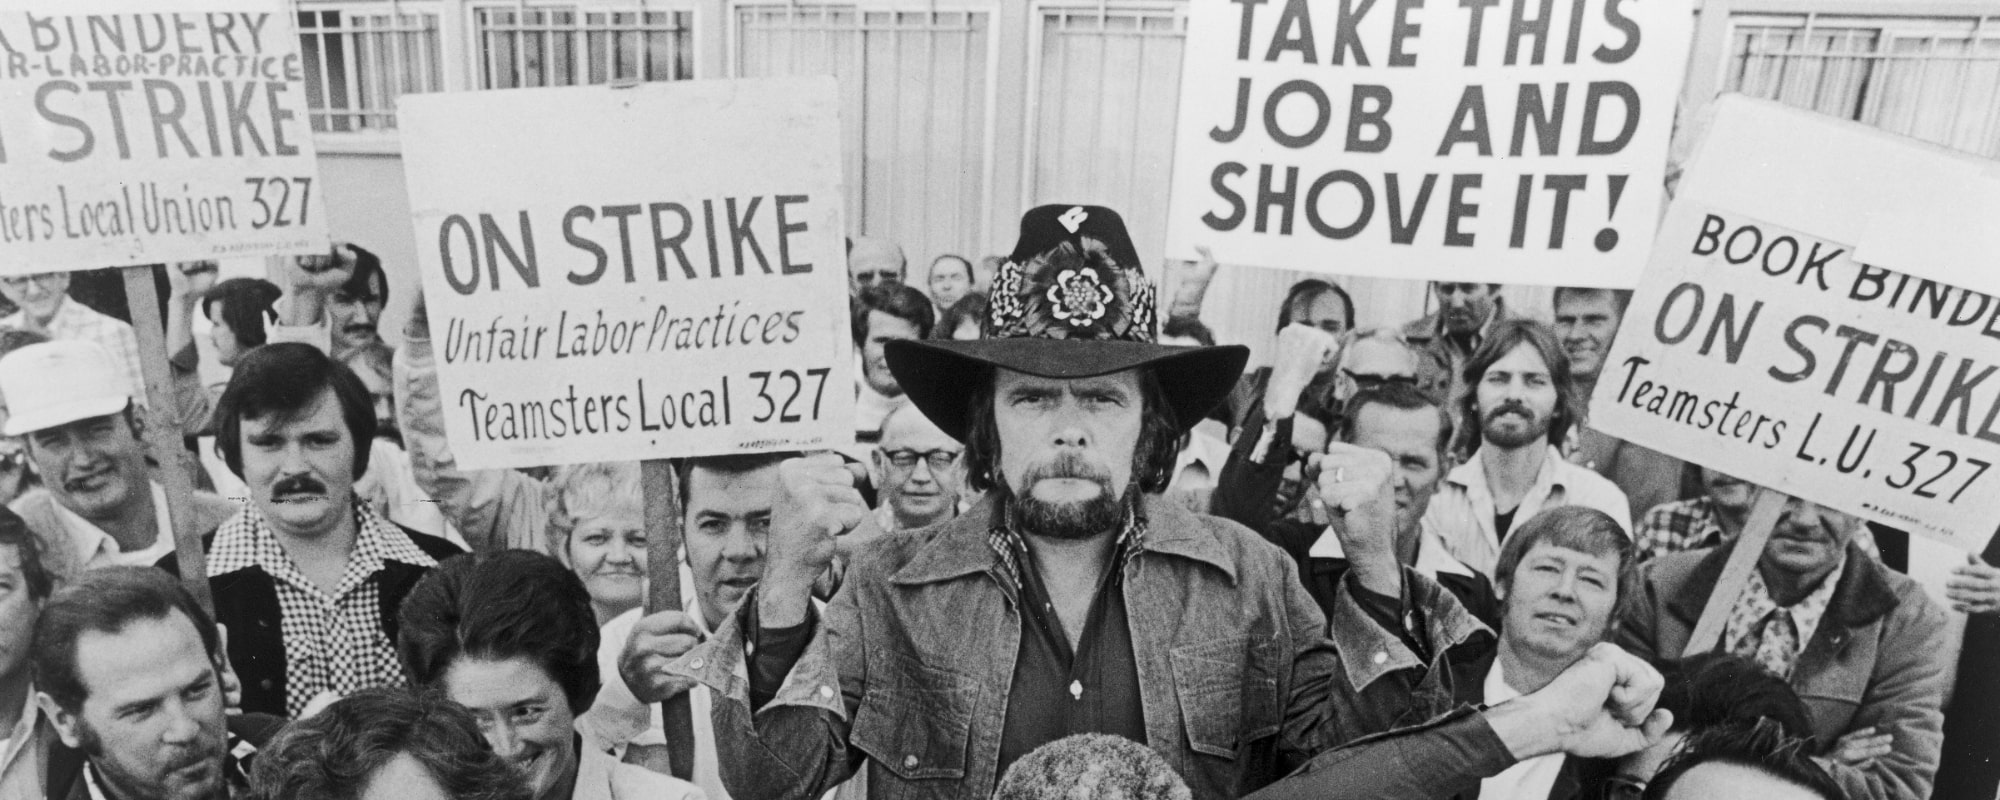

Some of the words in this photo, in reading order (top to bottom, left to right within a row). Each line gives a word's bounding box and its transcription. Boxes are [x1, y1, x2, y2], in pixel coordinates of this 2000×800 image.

[0, 51, 303, 82] R-LABOR-PRACTICE
[25, 9, 271, 55] BINDERY
[1230, 0, 1426, 68] TAKE
[1458, 0, 1642, 67] THIS
[34, 78, 301, 163] STRIKE
[1208, 77, 1394, 154] JOB
[1435, 80, 1642, 158] AND
[56, 184, 136, 239] Local
[140, 181, 238, 236] Union
[244, 176, 312, 230] 327
[438, 209, 541, 296] ON
[561, 194, 815, 286] STRIKE
[1200, 161, 1484, 248] SHOVE
[1508, 173, 1630, 253] IT!
[1690, 212, 1846, 292] BOOK
[444, 315, 548, 365] Unfair
[555, 309, 647, 360] Labor
[646, 300, 806, 352] Practices
[1653, 281, 1765, 365] ON
[459, 384, 632, 441] Teamsters
[637, 376, 732, 432] Local
[748, 367, 832, 424] 327
[1616, 354, 1788, 450] Teamsters
[1795, 411, 1878, 480] L.U.
[1884, 440, 1992, 504] 327
